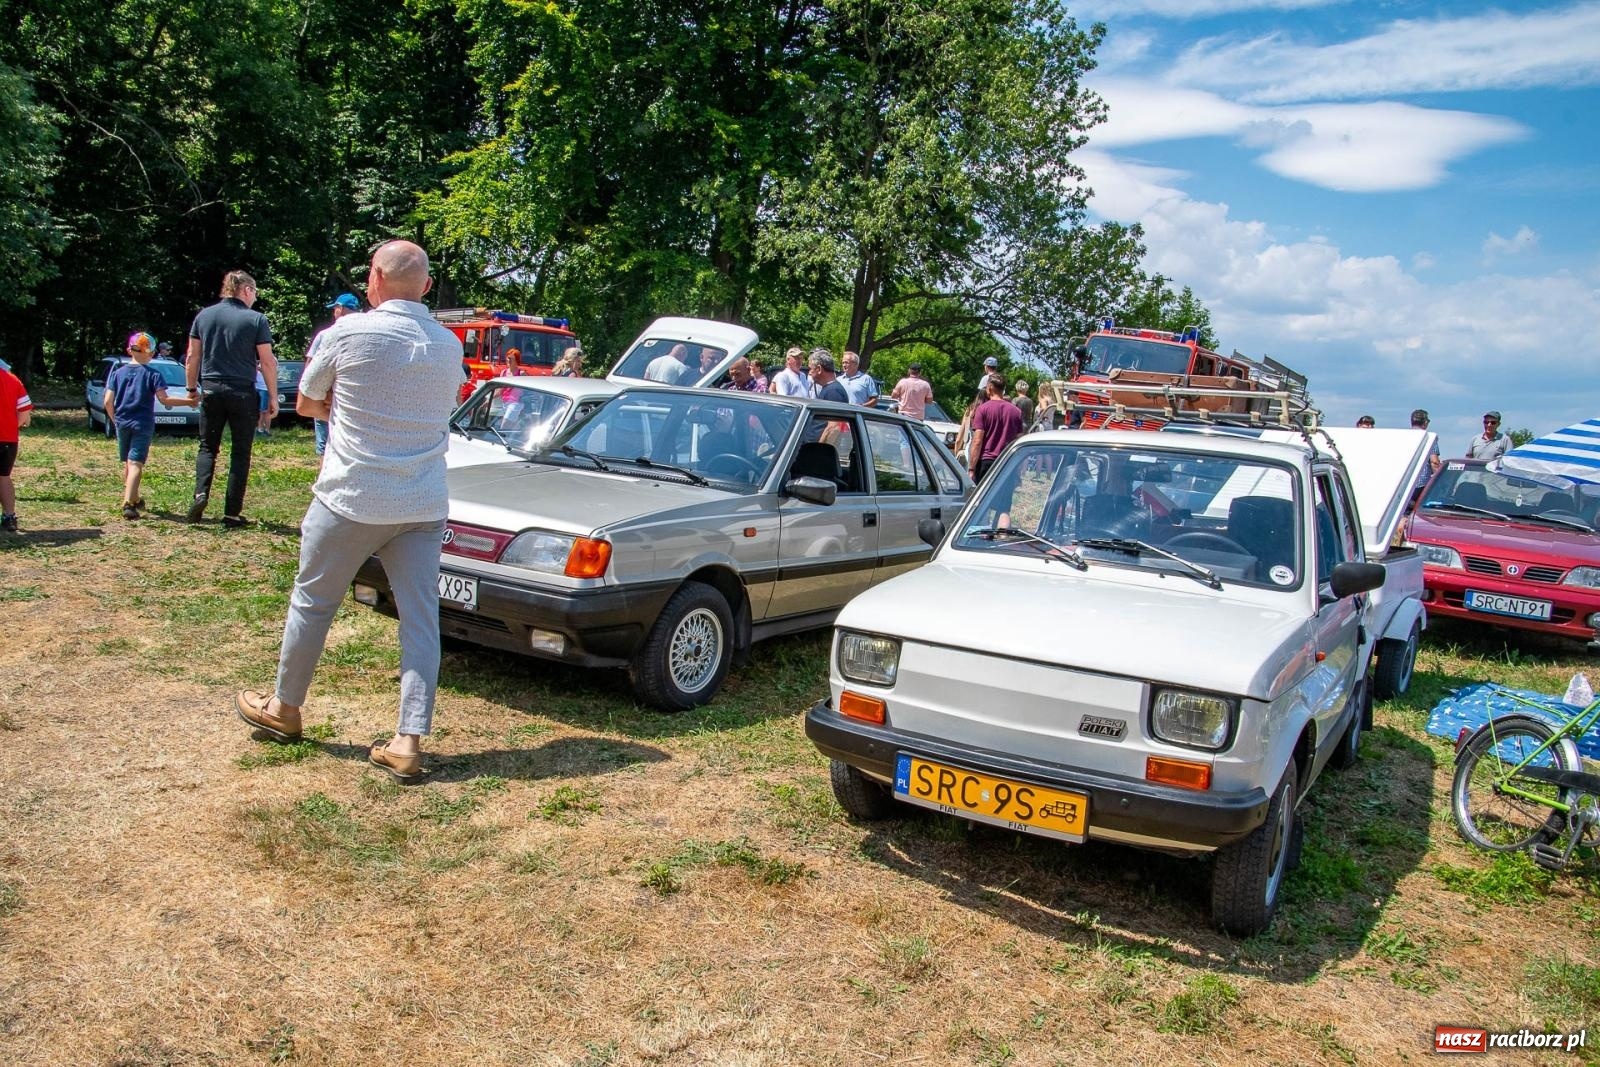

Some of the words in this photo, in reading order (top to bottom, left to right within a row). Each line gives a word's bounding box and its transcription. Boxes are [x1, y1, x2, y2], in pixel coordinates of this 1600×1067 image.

[1475, 594, 1504, 610] SRC
[1508, 599, 1545, 616] NT91
[1084, 716, 1122, 728] POLSKI
[1080, 723, 1121, 736] FIAT
[897, 778, 908, 789] PL
[916, 764, 980, 808] SRC
[993, 783, 1035, 821] 9S
[939, 804, 958, 815] FIAT
[1008, 821, 1029, 832] FIAT
